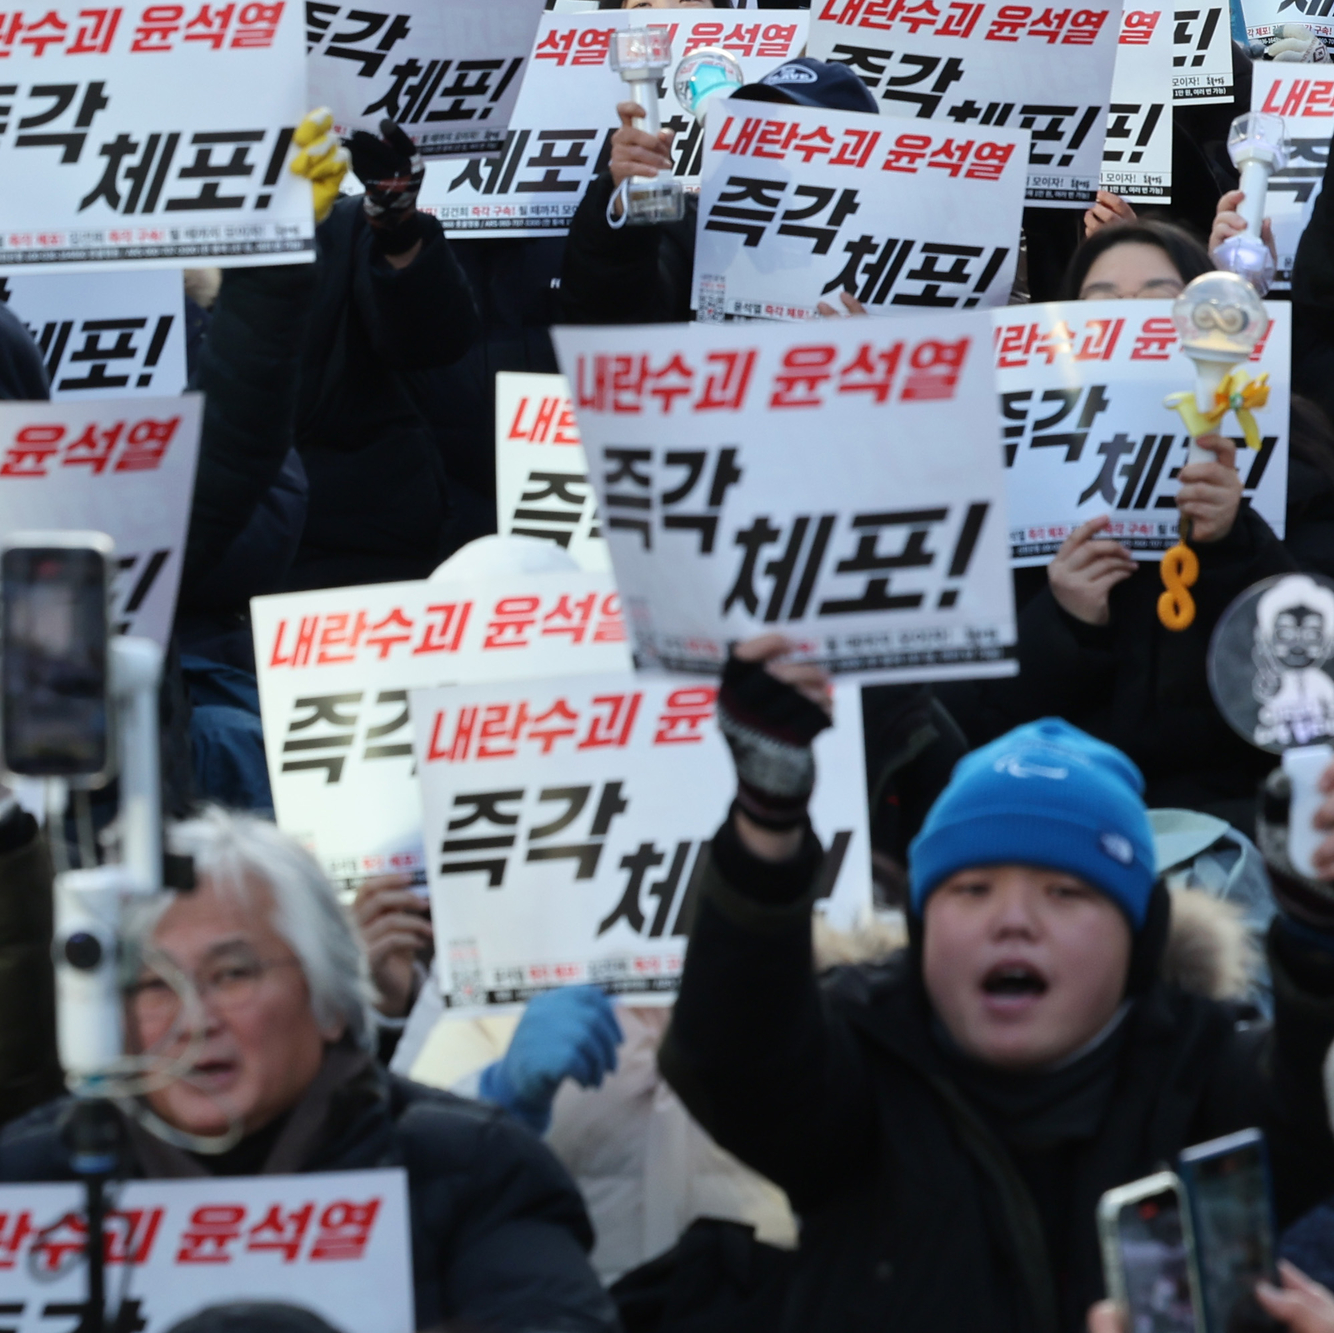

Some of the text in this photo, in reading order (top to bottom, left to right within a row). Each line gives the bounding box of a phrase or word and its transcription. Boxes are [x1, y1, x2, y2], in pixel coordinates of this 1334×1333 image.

[131, 2, 285, 52] 윤석열
[79, 127, 295, 214] 체포!
[713, 117, 1015, 180] 내란수괴 윤석열
[704, 176, 1009, 309] 즉각 체포!
[578, 338, 970, 413] 내란수괴 윤석열
[604, 448, 989, 623] 즉각 체포!
